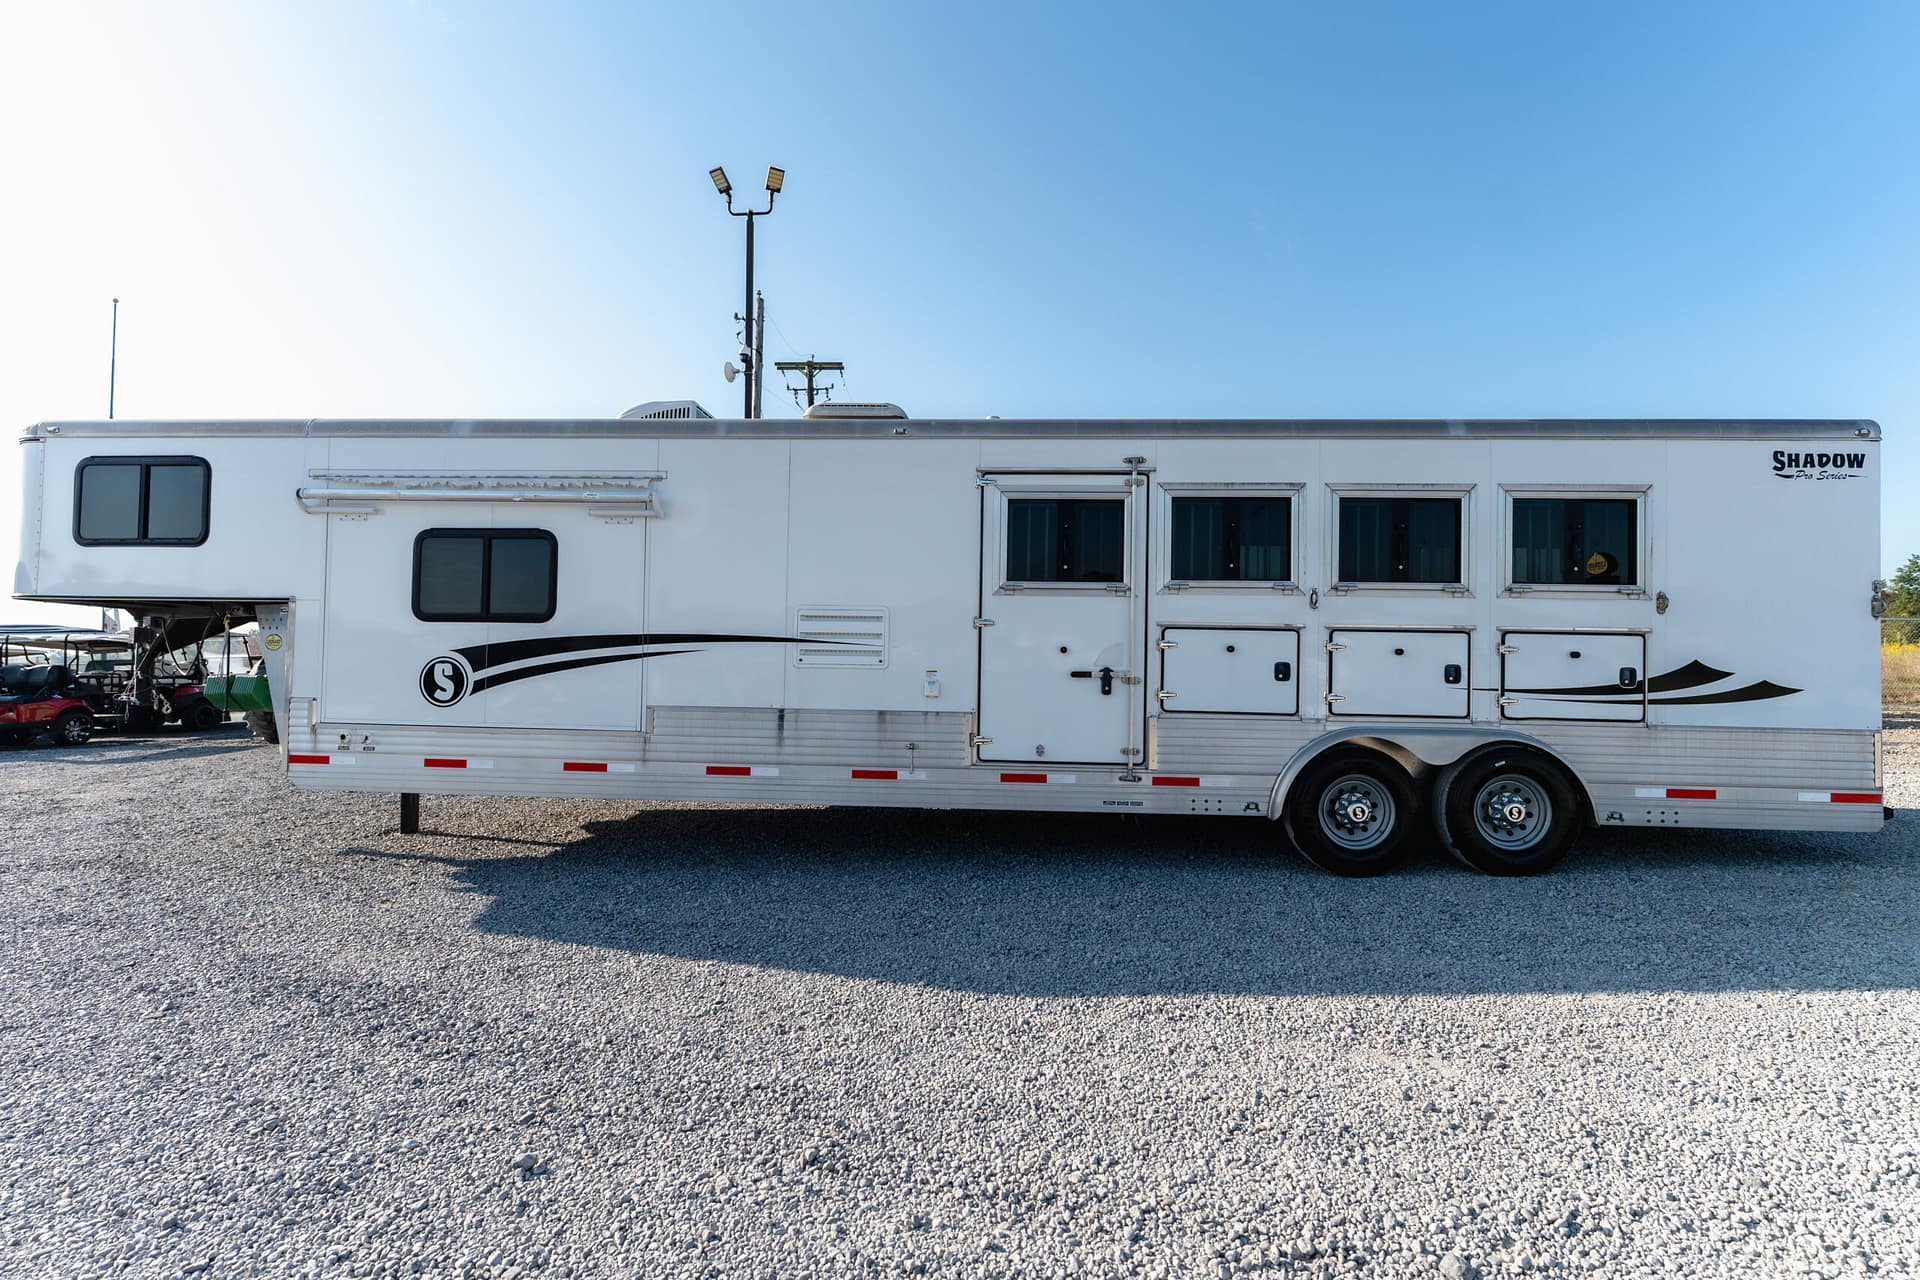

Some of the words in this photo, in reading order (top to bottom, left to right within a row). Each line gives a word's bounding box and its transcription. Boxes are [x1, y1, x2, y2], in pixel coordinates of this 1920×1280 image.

[1772, 450, 1866, 472] SHADOW
[1794, 470, 1813, 480] Pro
[1816, 470, 1848, 480] Series
[433, 662, 455, 701] S
